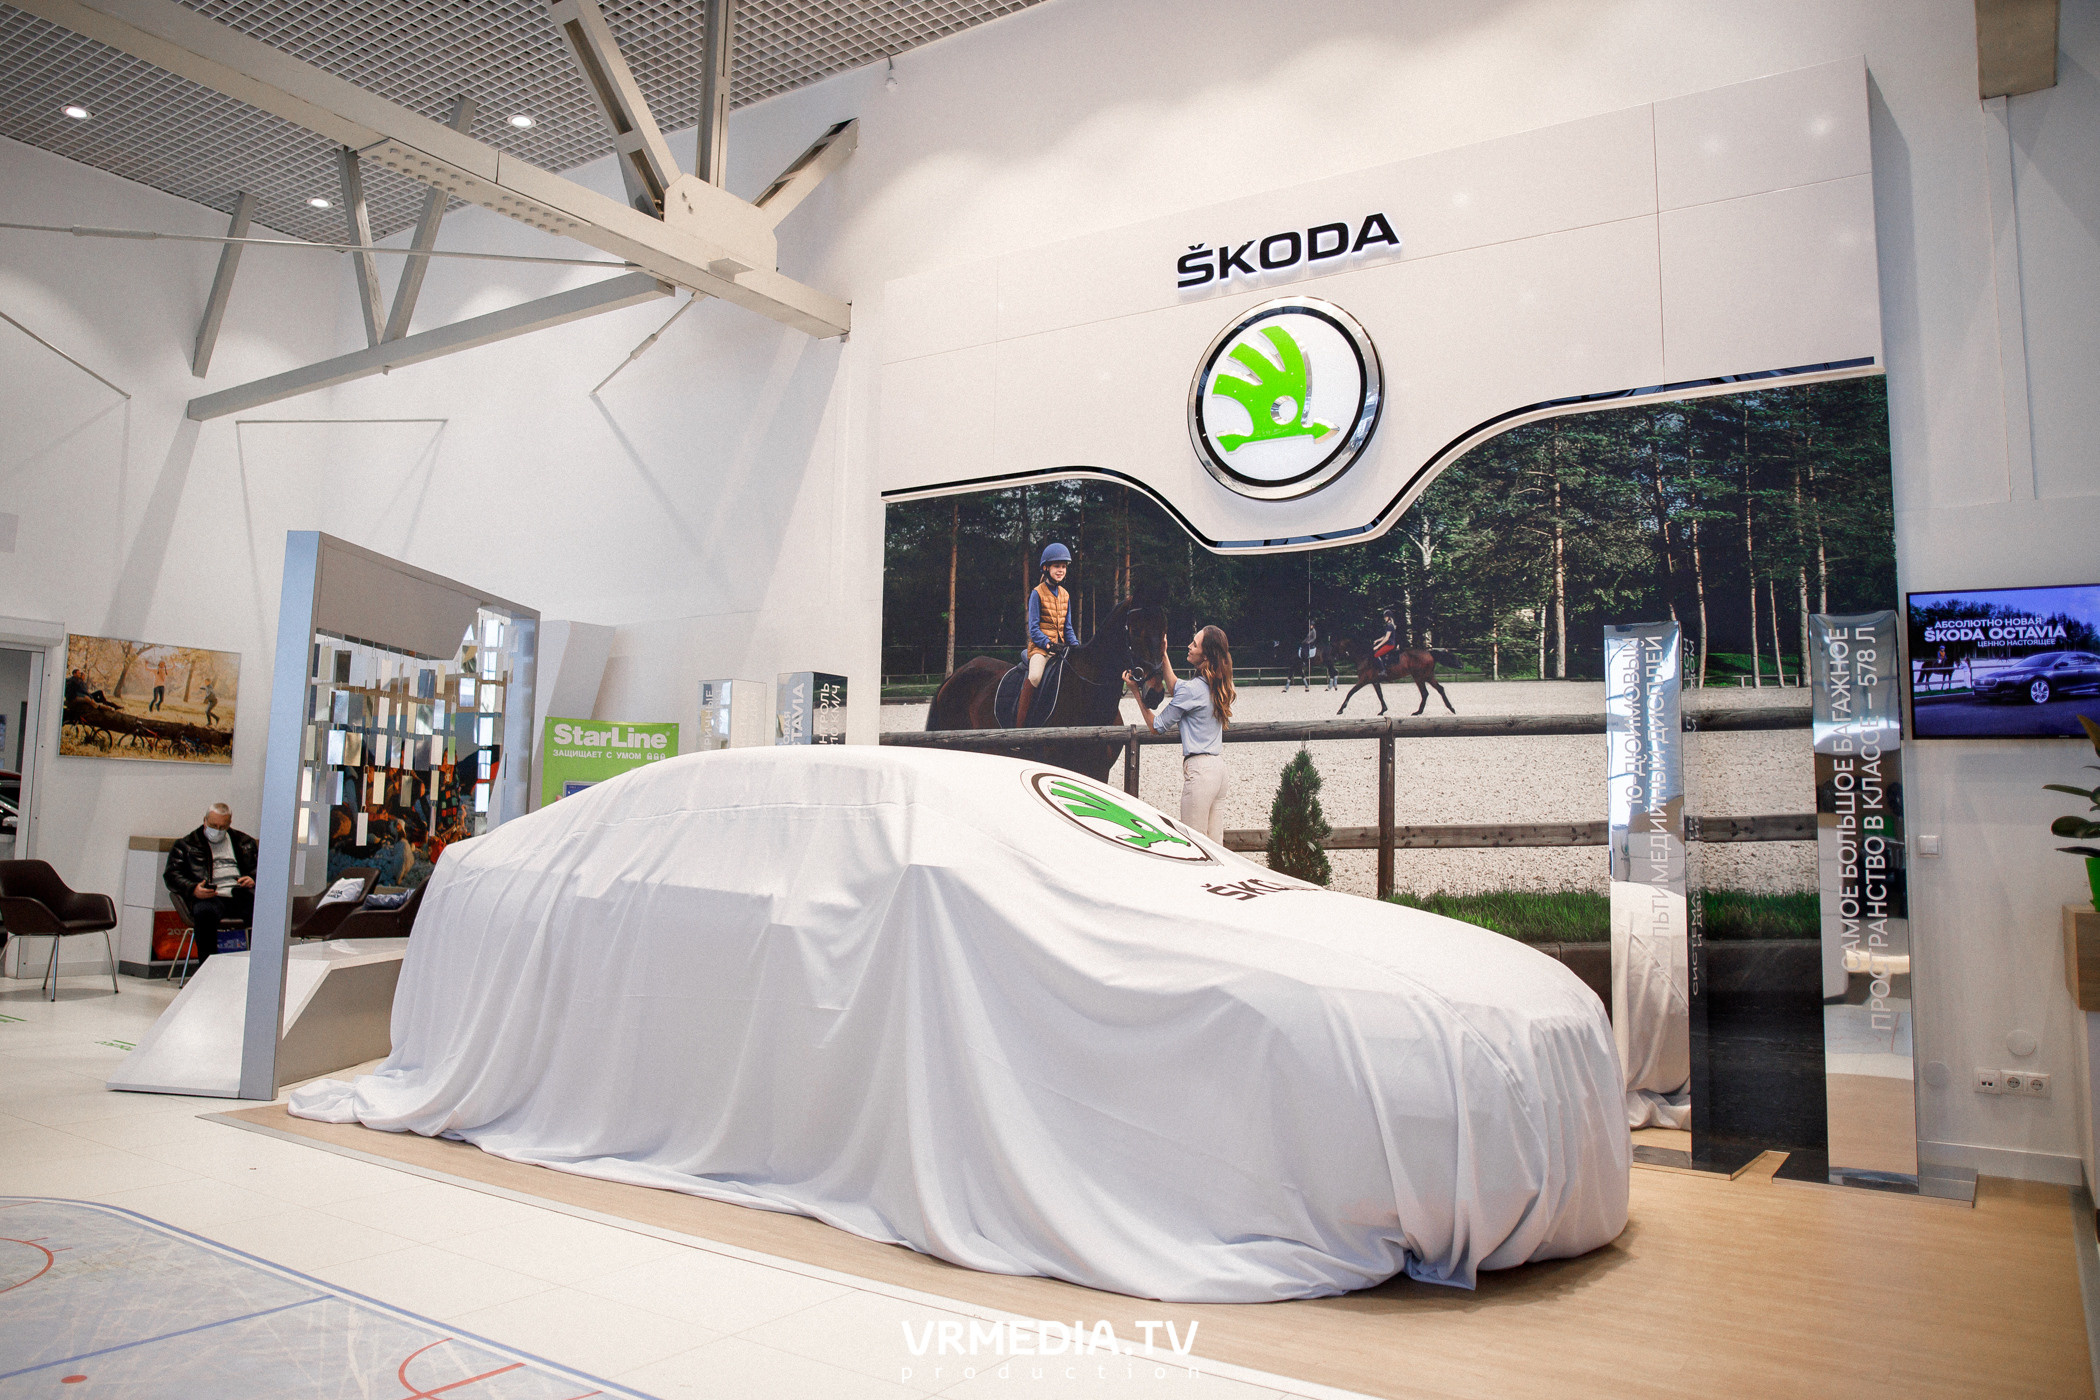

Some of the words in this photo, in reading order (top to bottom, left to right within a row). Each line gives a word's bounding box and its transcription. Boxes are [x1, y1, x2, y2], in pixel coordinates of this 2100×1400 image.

[1177, 212, 1400, 289] ŠKODA
[1854, 626, 1876, 644] Л
[1924, 627, 1985, 642] ŠKODA
[1988, 625, 2067, 639] OCTAVIA
[1934, 618, 2002, 629] АБСОЛЮТНО
[2004, 617, 2042, 627] НОВАЯ
[1977, 639, 2006, 648] ЦЕННО
[2006, 638, 2056, 647] НАСТОЯЩЕЕ
[1855, 648, 1878, 687] 578
[831, 684, 842, 723] КМ/Ч
[1640, 635, 1669, 744] ДИСПЛЕЙ
[1827, 627, 1852, 752] БАГАЖНОЕ
[783, 711, 791, 745] ОВАЯ
[791, 682, 805, 746] TAVIA
[818, 683, 830, 744] НТРОЛЬ
[552, 749, 603, 760] ЗАЩИЩАЕТ
[616, 751, 642, 761] УМОМ
[553, 723, 669, 750] StarLine
[1859, 716, 1883, 809] КЛАССЕ
[1832, 759, 1858, 878] БОЛЬШОЕ
[1863, 815, 1884, 831] В
[1838, 885, 1863, 972] САМОЕ
[1862, 835, 1892, 1031] ПРОСТРАНСТВО
